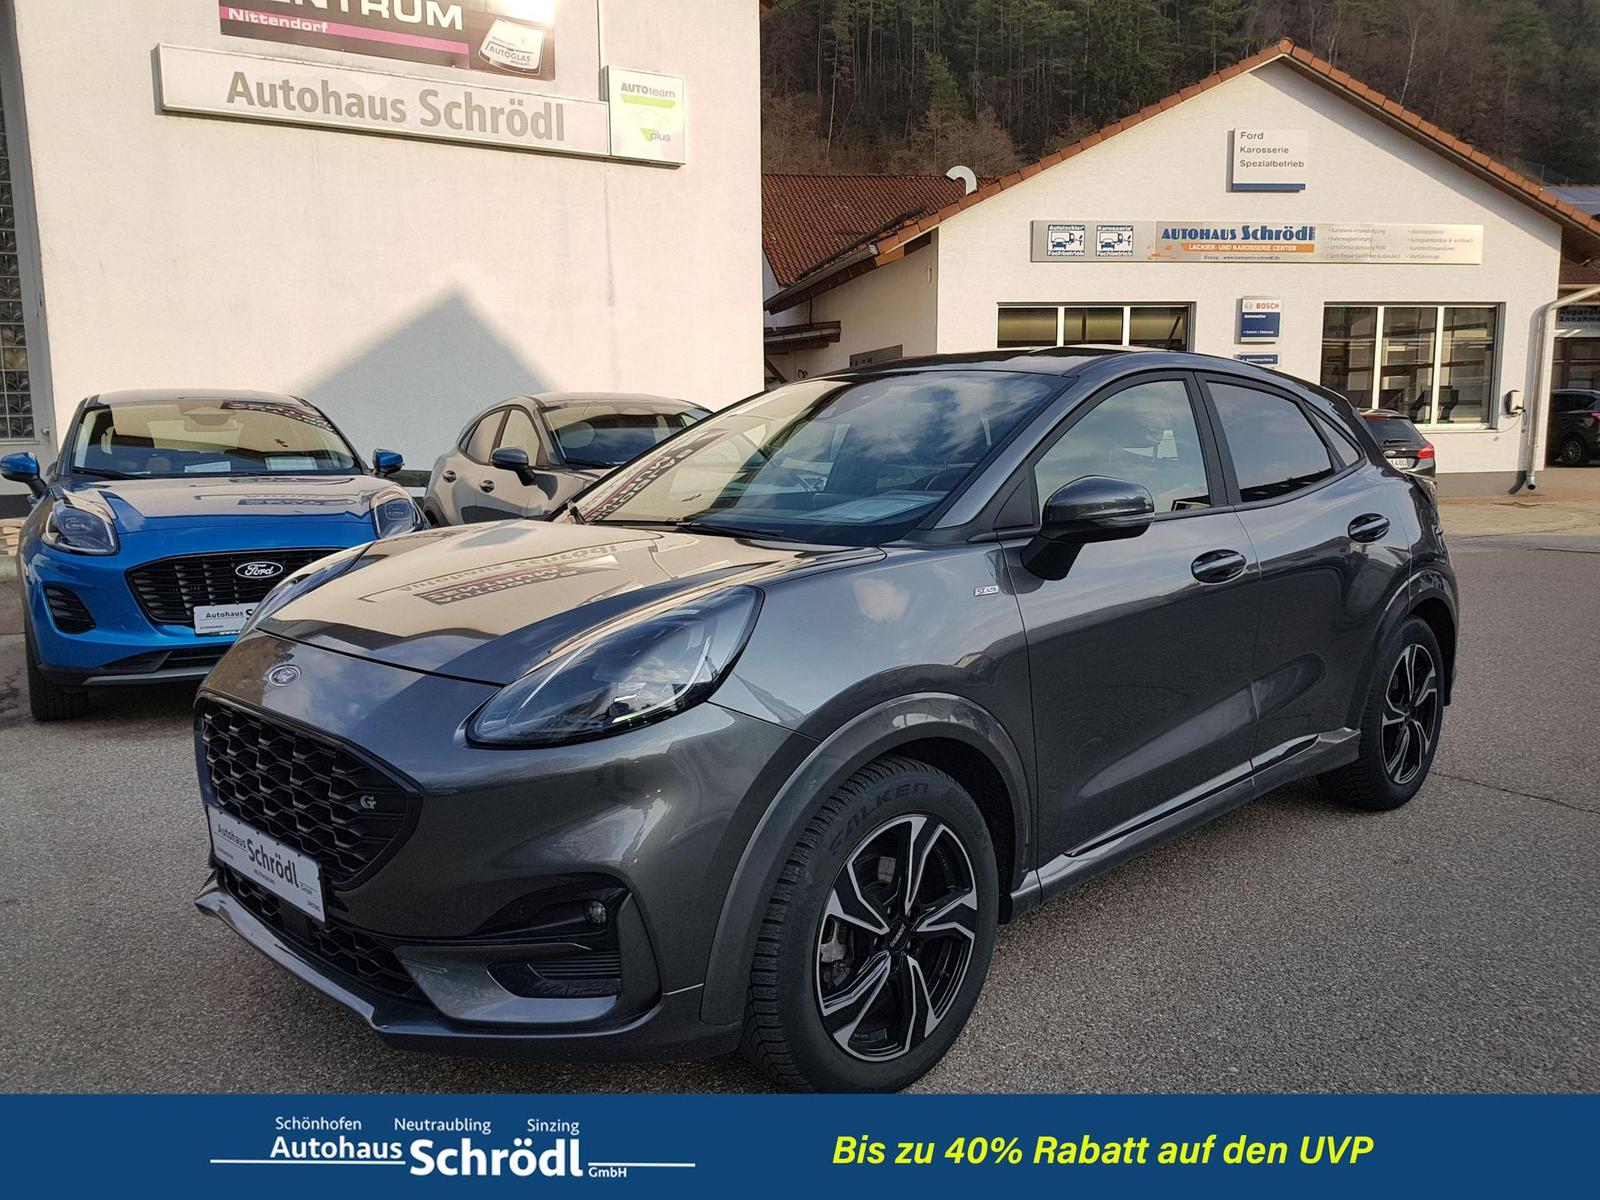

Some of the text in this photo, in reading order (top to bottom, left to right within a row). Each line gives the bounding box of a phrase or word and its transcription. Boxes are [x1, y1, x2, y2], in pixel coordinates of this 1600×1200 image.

[228, 8, 329, 33] Nittendorf
[488, 45, 532, 62] AUTOGLAS
[620, 82, 676, 99] AUTOteam
[226, 71, 566, 142] Autohaus Schrödl
[650, 128, 672, 143] plus
[1240, 131, 1264, 140] Ford
[1240, 145, 1289, 154] Karosserie
[1239, 159, 1305, 168] Spezialbetrieb
[1161, 228, 1237, 240] AUTOHAUS
[1241, 225, 1316, 241] Schrödl
[205, 610, 244, 619] Autohaus
[217, 824, 300, 889] Autohaus Schrödl
